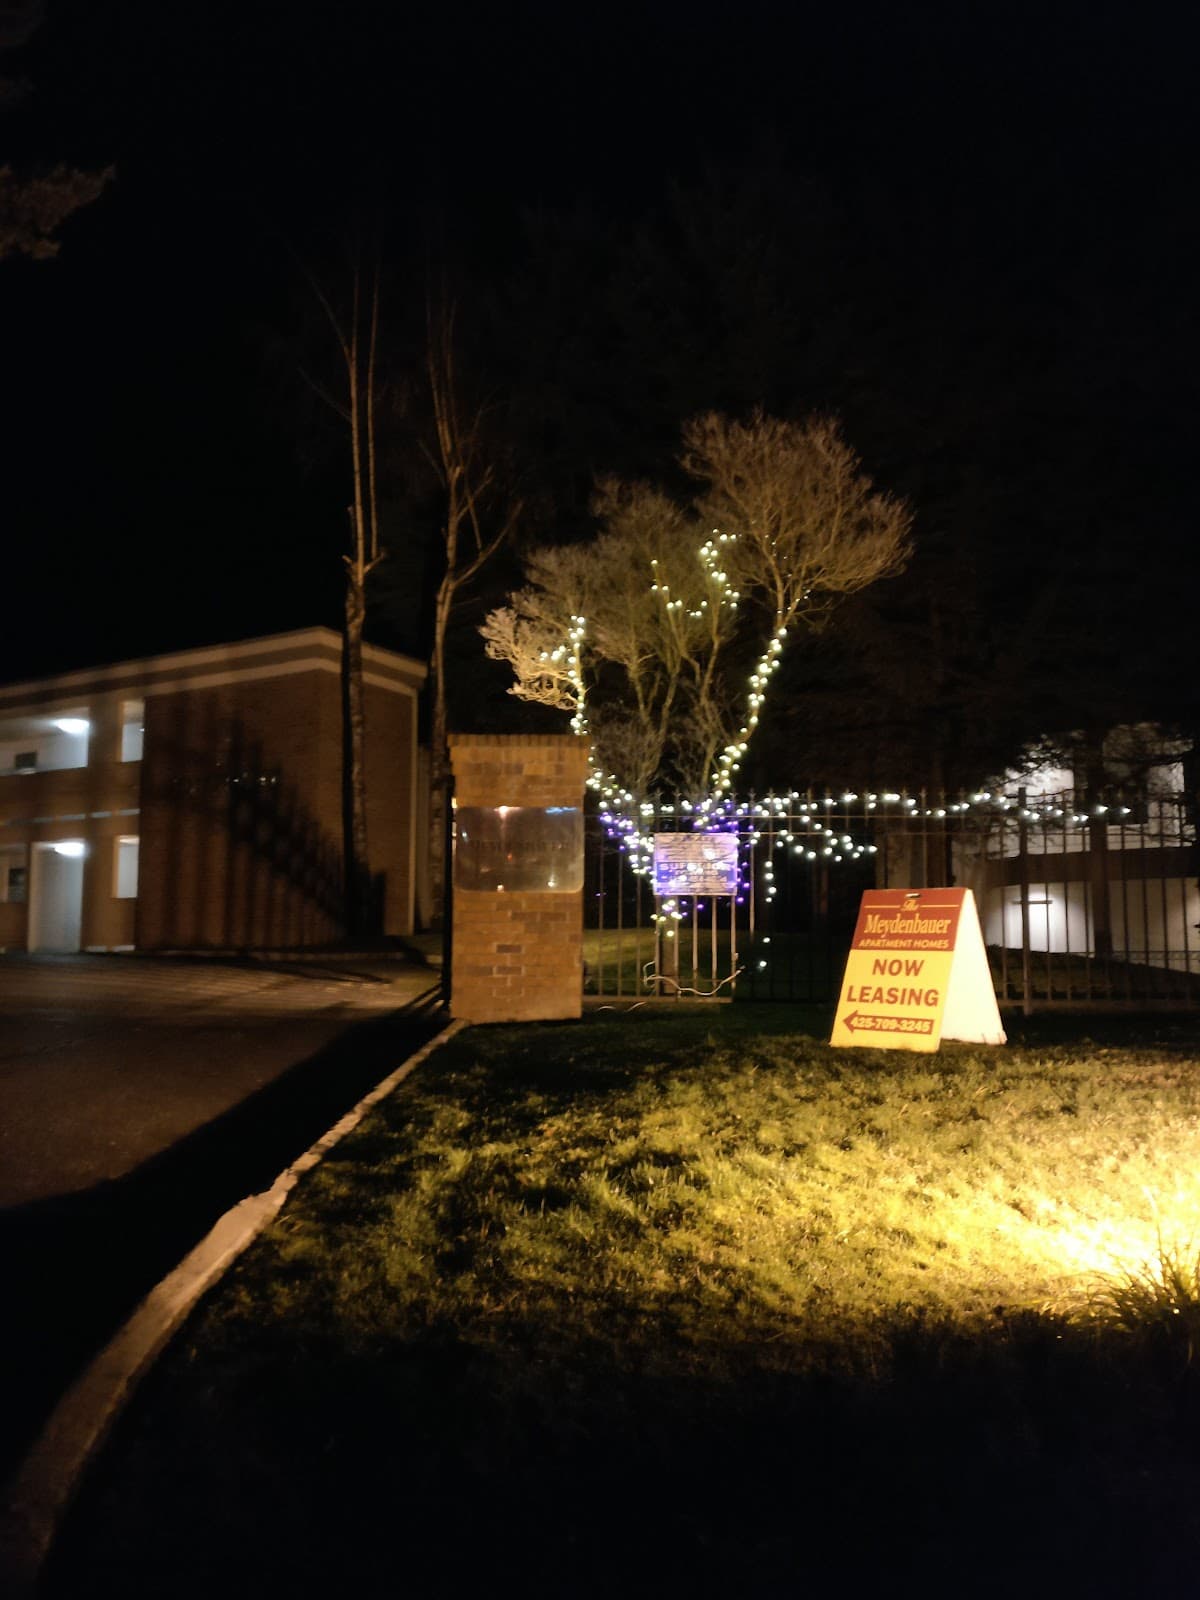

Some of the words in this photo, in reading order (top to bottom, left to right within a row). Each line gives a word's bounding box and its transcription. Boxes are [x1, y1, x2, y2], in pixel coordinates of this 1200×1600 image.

[901, 899, 919, 911] The
[864, 913, 951, 937] Meydenbauer
[859, 939, 912, 947] APARTMENT
[915, 940, 949, 948] HOMES
[872, 959, 924, 976] NOW
[847, 986, 939, 1006] LEASING
